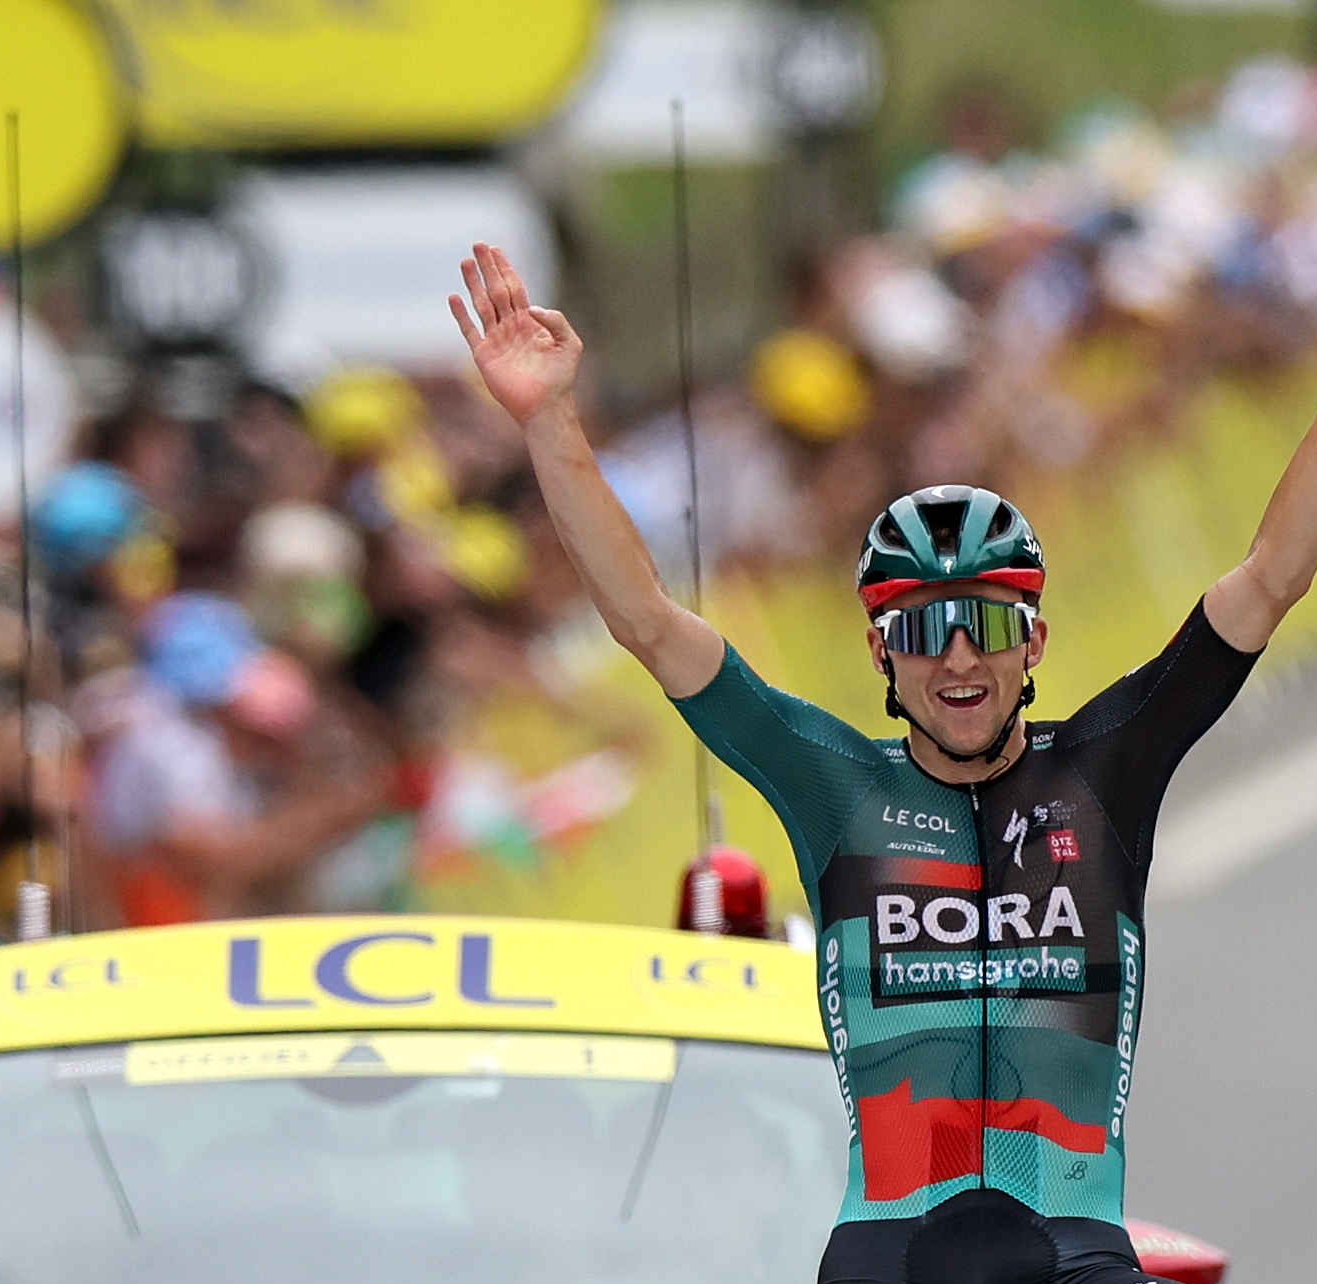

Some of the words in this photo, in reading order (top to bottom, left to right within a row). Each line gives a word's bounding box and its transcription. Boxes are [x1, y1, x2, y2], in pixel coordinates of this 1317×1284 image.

[883, 805, 910, 826] LE
[914, 813, 957, 833] COL
[887, 842, 915, 851] AUTO
[876, 886, 1085, 945] BORA
[12, 957, 142, 996] LCL
[229, 932, 556, 1006] LCL
[651, 954, 779, 997] LCL
[885, 946, 1080, 985] hansgrohe
[1111, 928, 1140, 1138] hansgrohe
